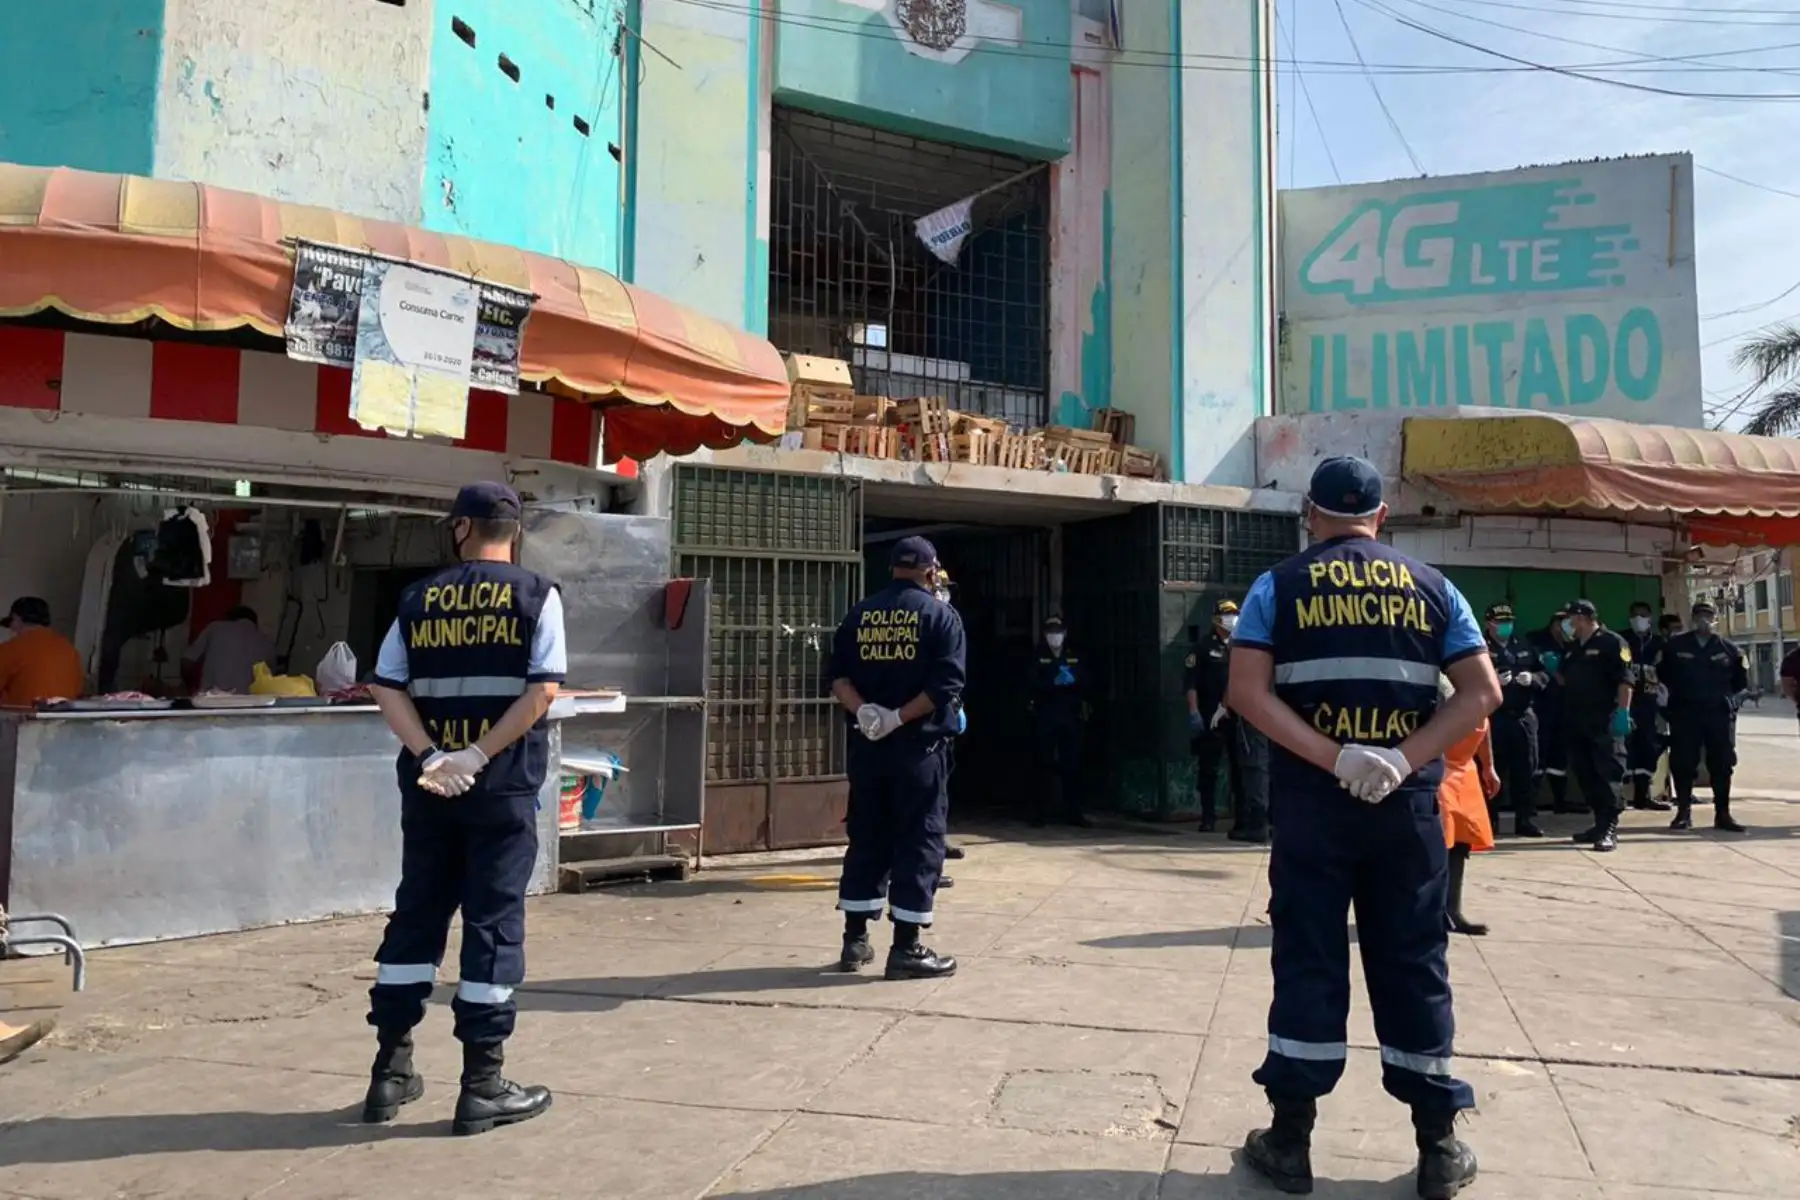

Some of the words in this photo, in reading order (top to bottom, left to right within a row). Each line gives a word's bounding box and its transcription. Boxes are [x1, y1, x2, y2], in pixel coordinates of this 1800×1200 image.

[1307, 201, 1460, 294] 4G
[1471, 238, 1560, 285] LTE
[1308, 306, 1663, 413] ILIMITADO
[1308, 559, 1416, 591] POLICIA
[424, 582, 513, 613] POLICIA
[1296, 592, 1433, 634] MUNICIPAL
[411, 615, 523, 648] MUNICIPAL
[861, 610, 919, 625] POLICIA
[856, 626, 920, 642] MUNICIPAL
[860, 644, 916, 660] CALLAO
